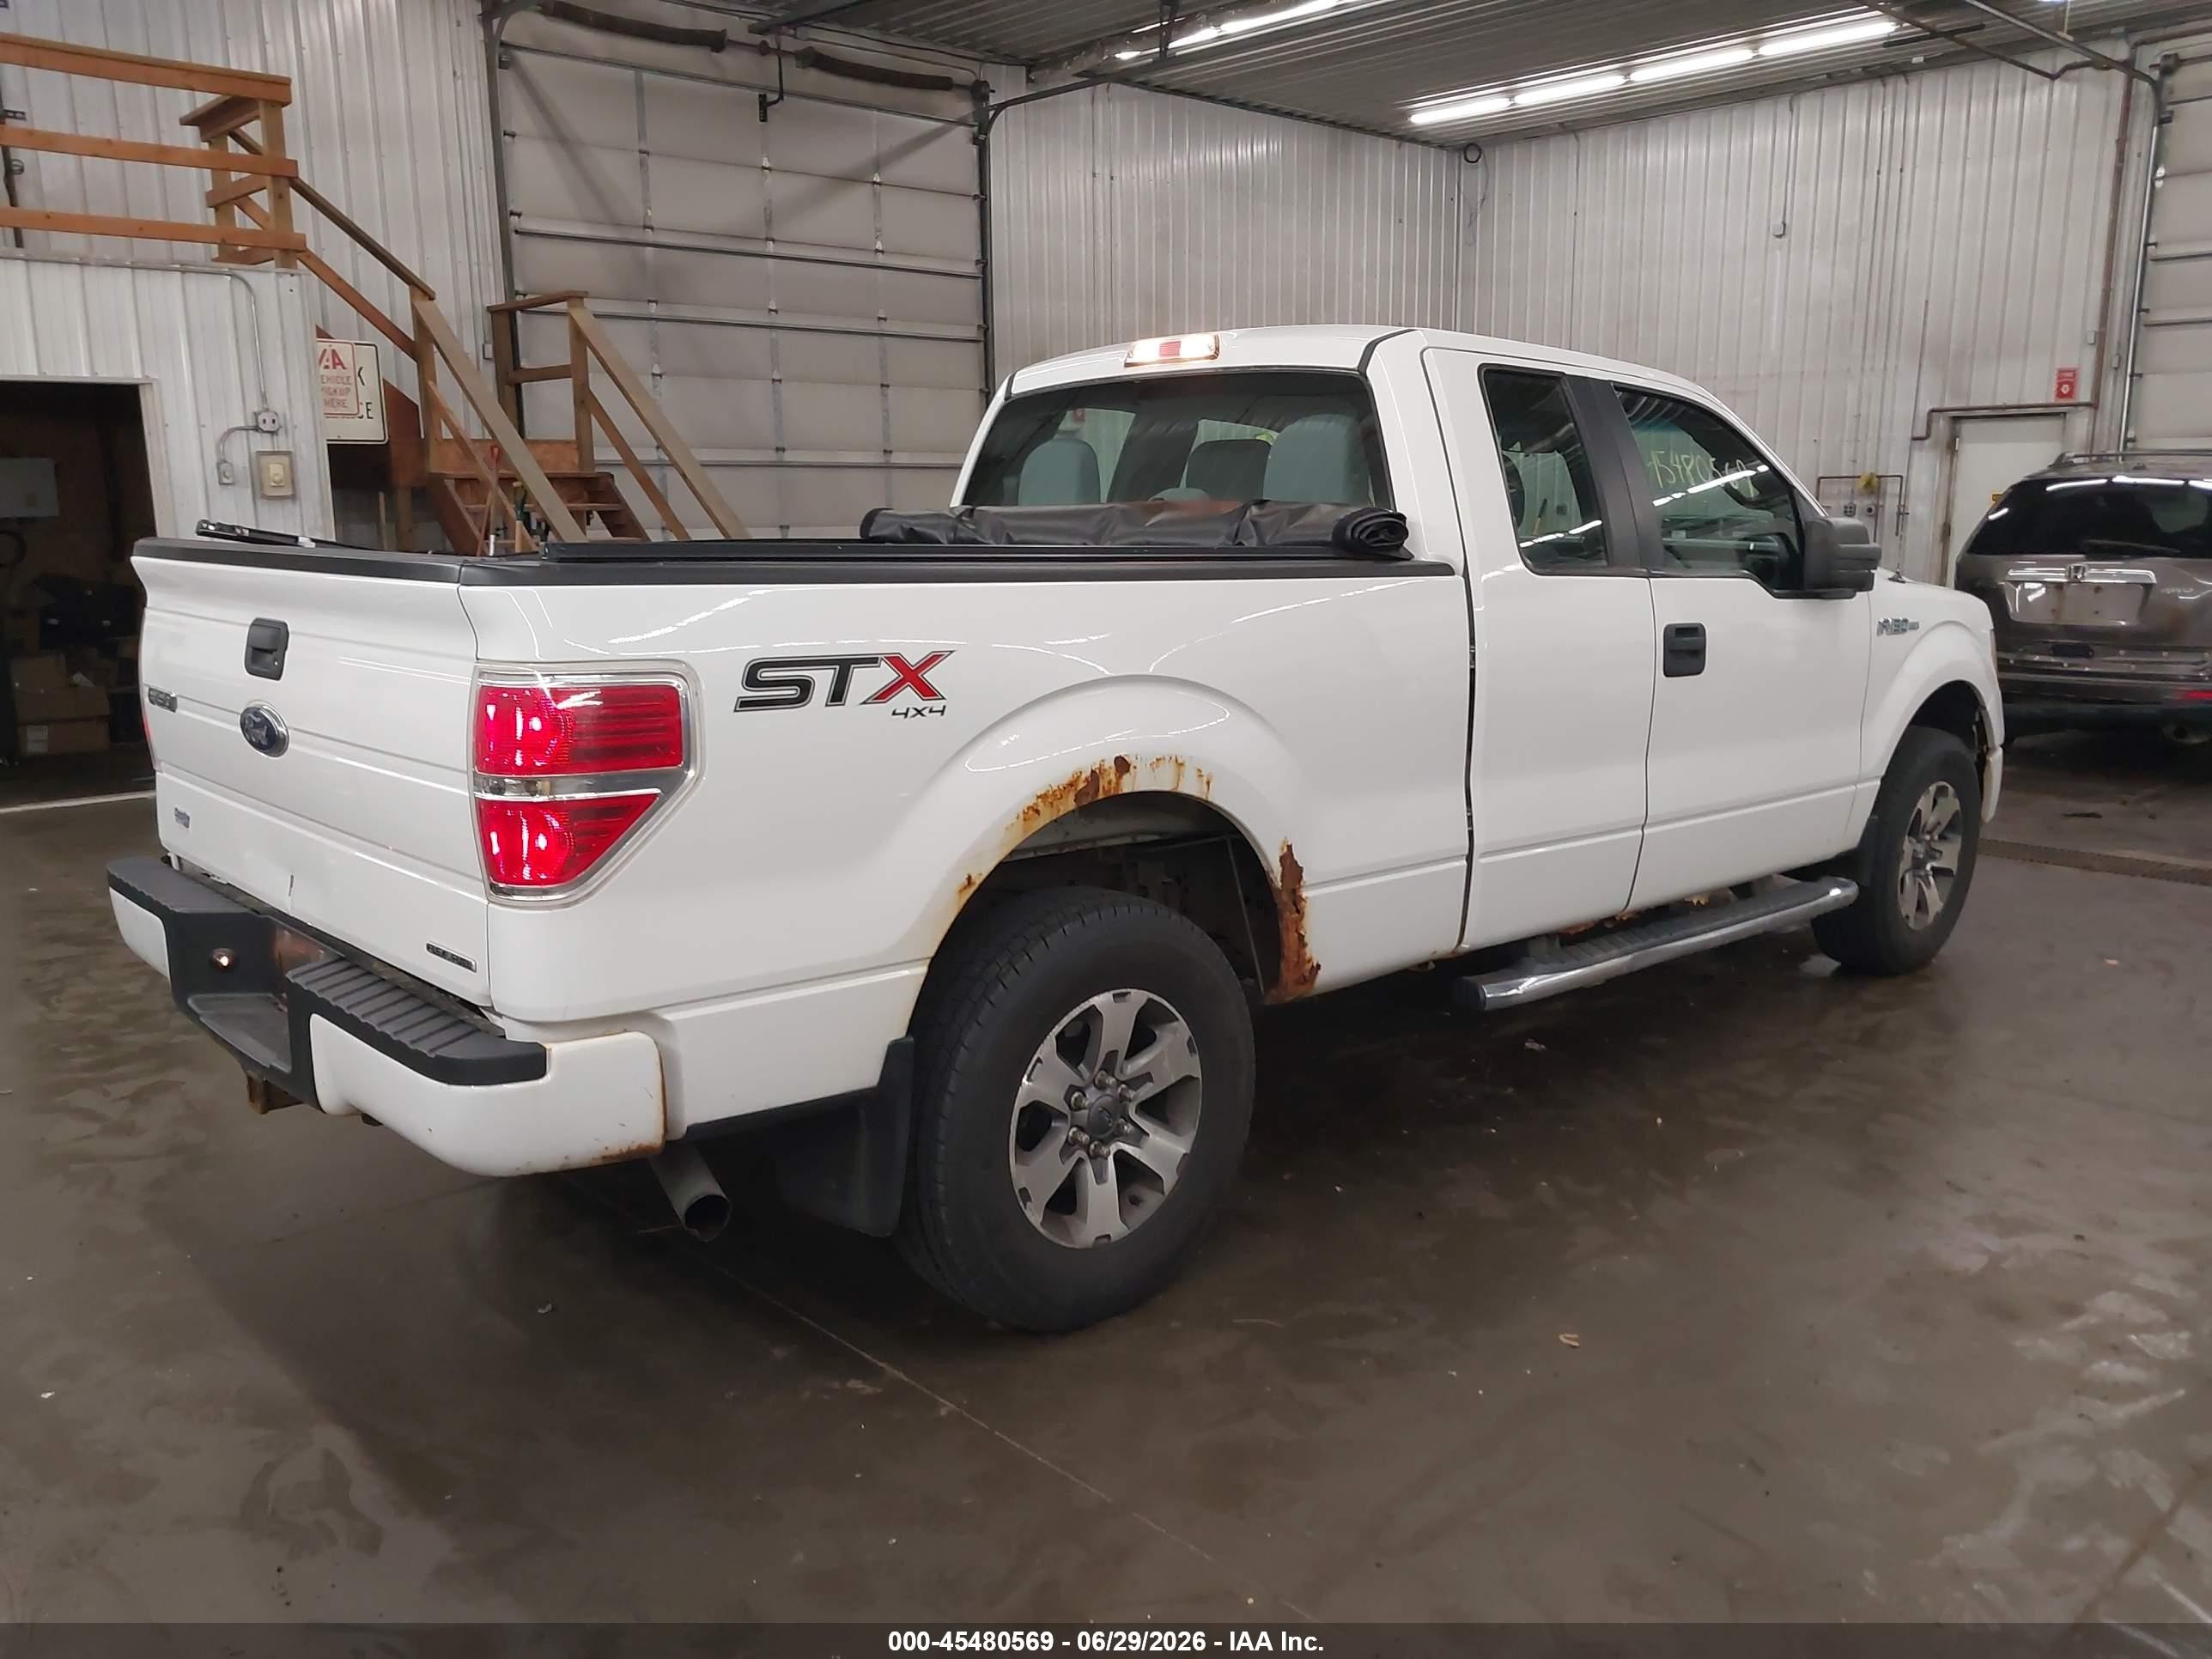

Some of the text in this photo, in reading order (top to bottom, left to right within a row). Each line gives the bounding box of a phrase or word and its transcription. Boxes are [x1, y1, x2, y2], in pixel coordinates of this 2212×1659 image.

[320, 374, 352, 386] EHICLE
[321, 386, 351, 396] ICKUP
[733, 650, 957, 713] STX
